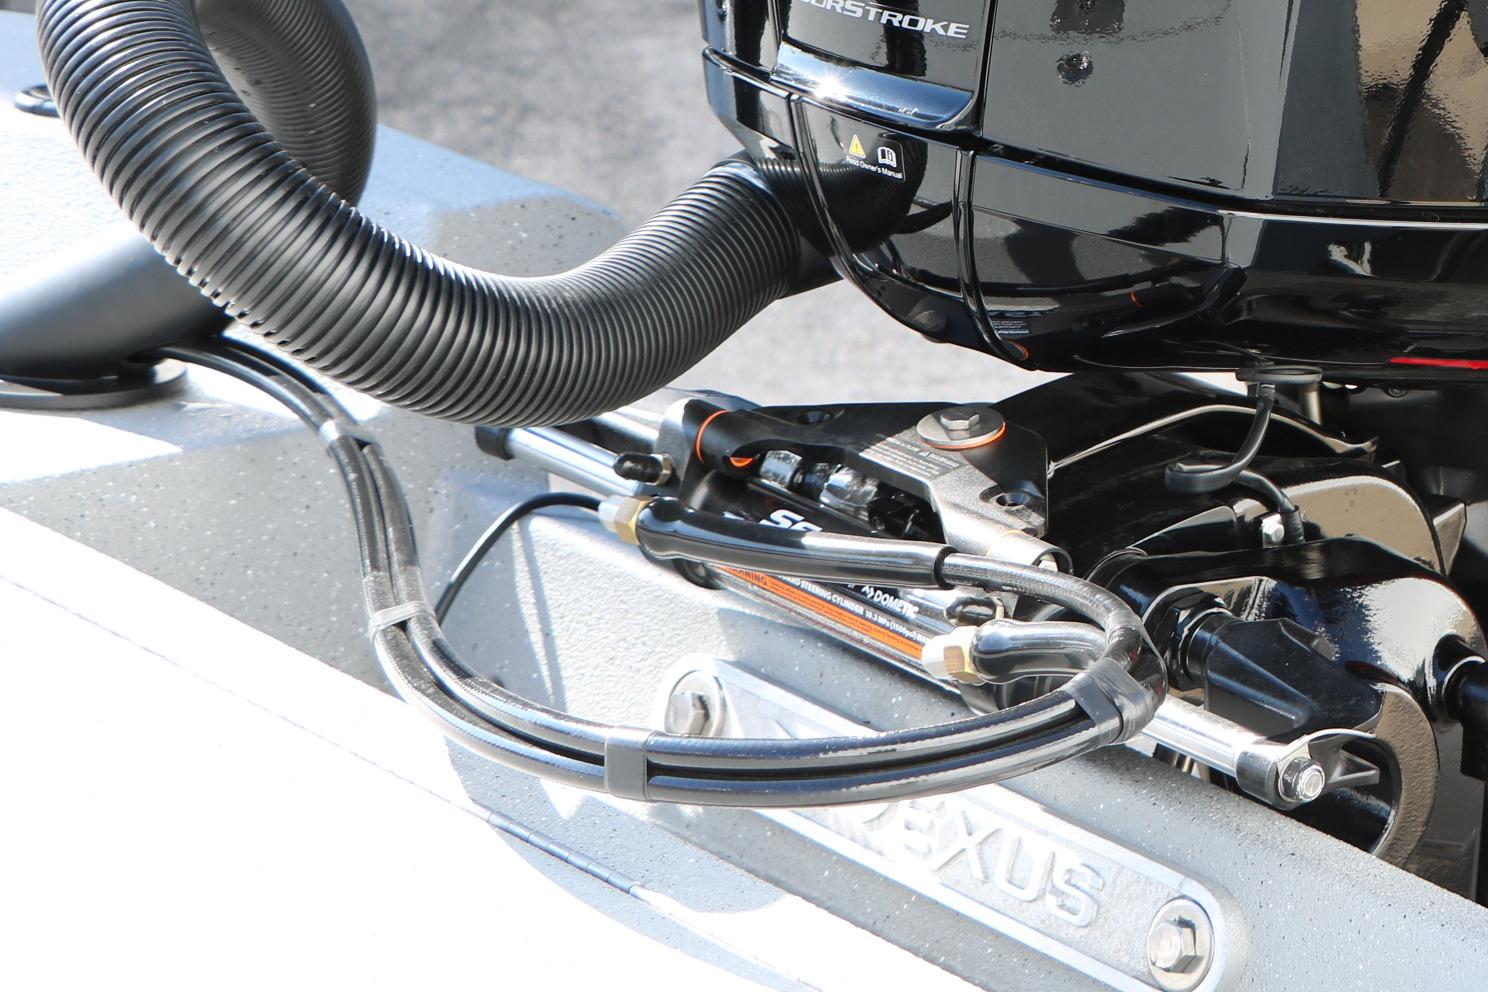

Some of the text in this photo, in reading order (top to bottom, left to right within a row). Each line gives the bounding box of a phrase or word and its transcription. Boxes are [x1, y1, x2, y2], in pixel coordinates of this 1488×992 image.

[800, 580, 832, 601] STEERING
[831, 593, 865, 616] CYLINDER
[873, 589, 920, 619] DOMETIC
